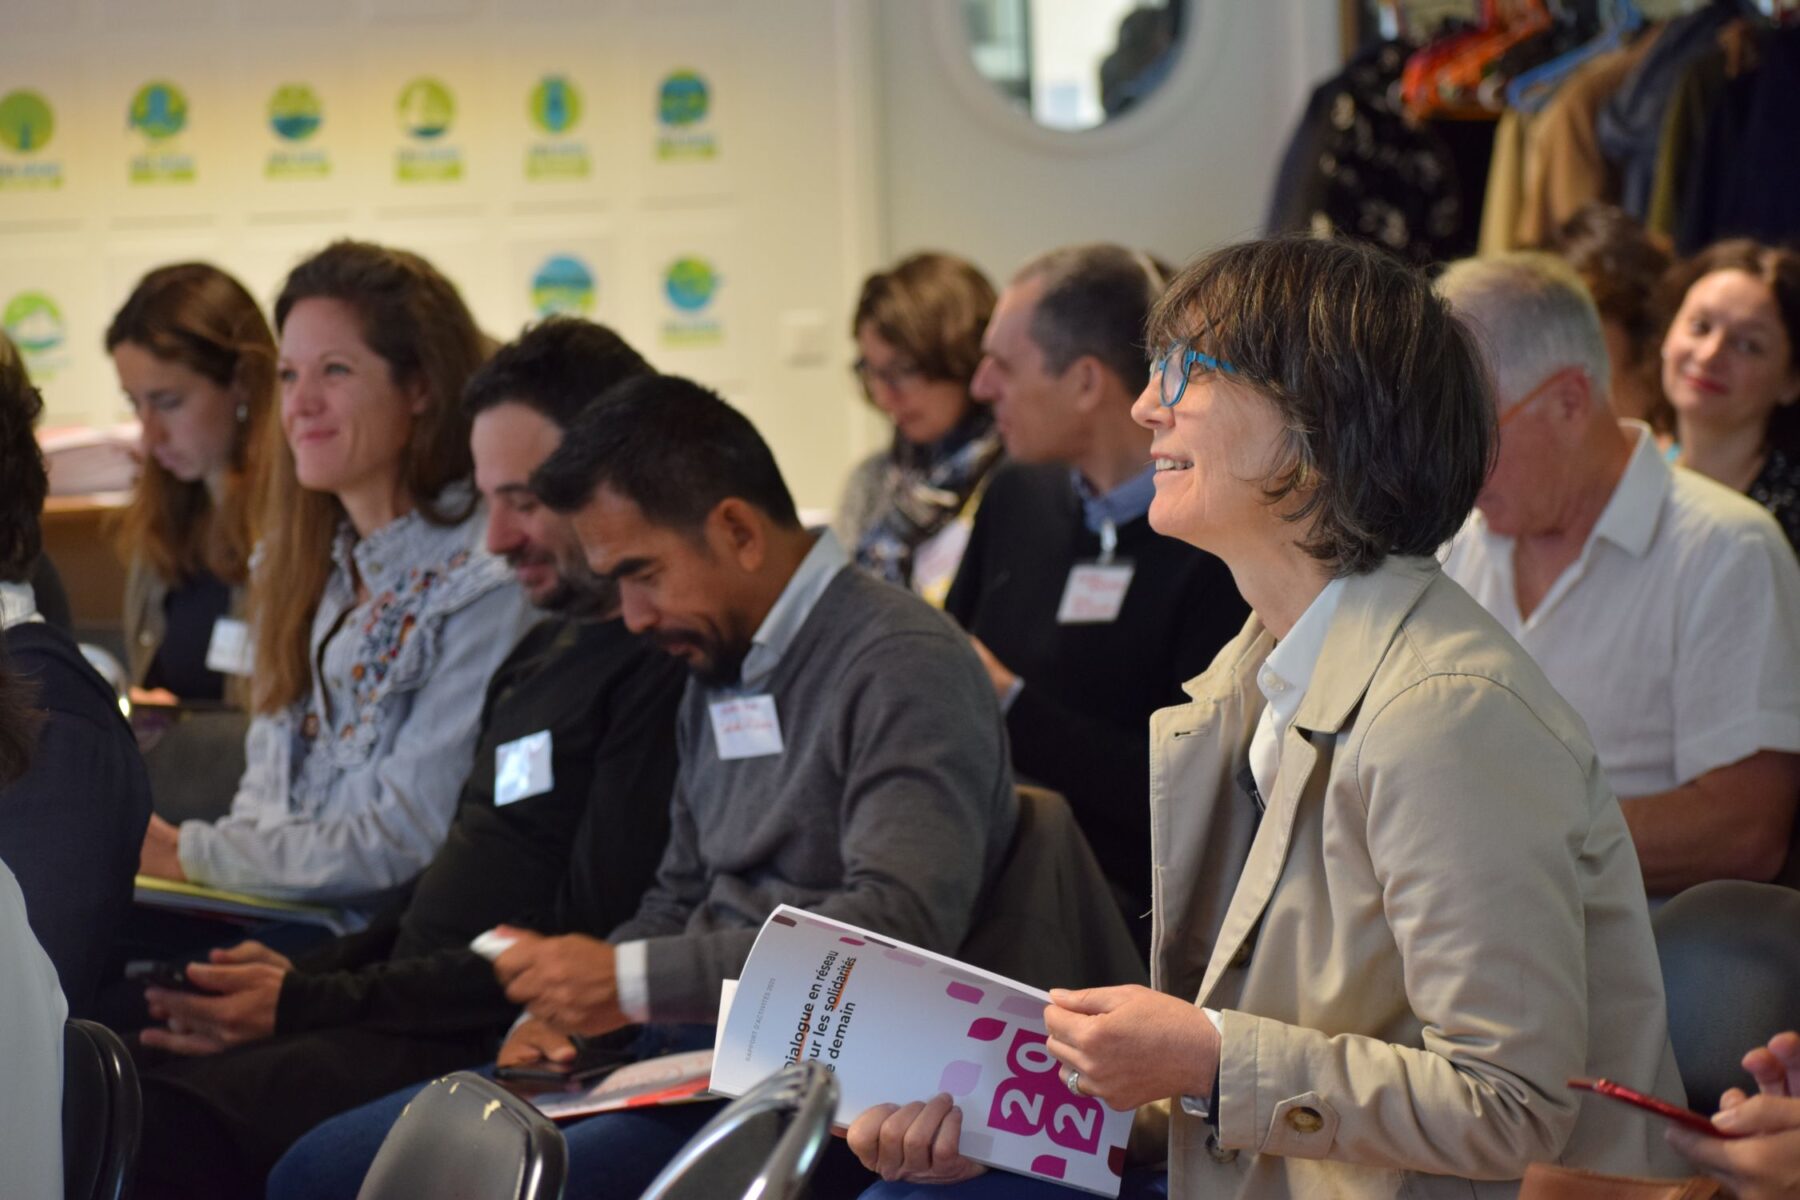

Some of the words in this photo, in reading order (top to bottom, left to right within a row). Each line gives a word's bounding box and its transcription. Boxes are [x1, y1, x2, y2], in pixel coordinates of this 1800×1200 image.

[815, 950, 839, 981] réseau
[808, 983, 823, 1000] en
[812, 1014, 830, 1037] les
[824, 956, 857, 1012] solidarités
[828, 1002, 856, 1059] demain
